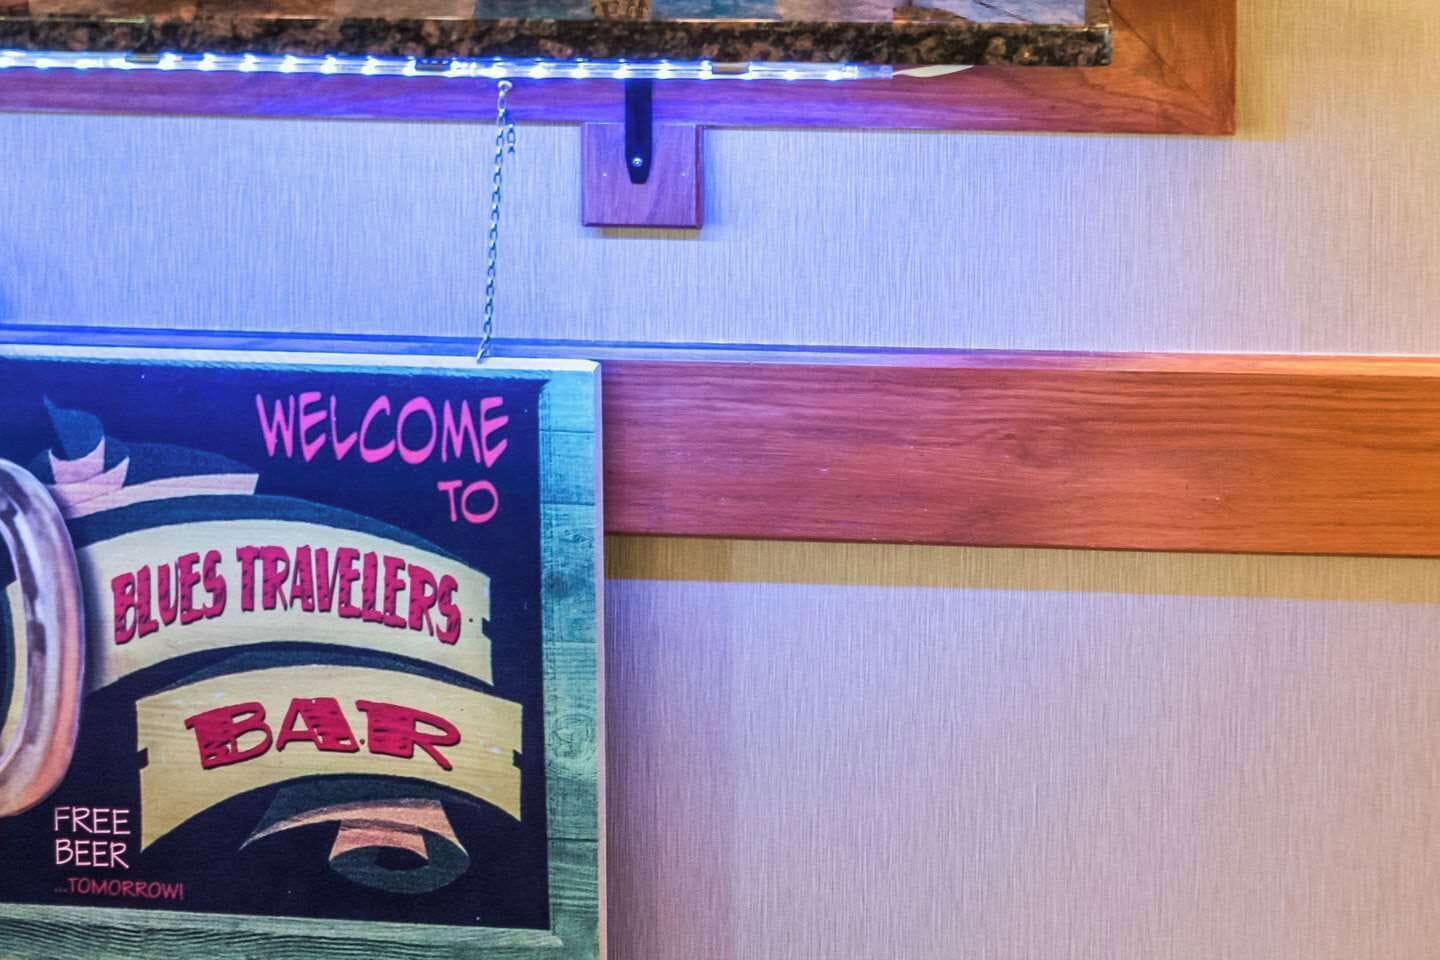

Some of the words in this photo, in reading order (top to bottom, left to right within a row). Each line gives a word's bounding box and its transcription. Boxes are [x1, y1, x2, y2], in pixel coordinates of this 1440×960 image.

[255, 391, 509, 468] WELCOME
[436, 479, 499, 525] TO
[110, 549, 228, 645] BLUES
[235, 544, 462, 646] TRAVELERS
[184, 696, 462, 772] BAR
[53, 806, 131, 836] FREE
[55, 838, 130, 869] BEER
